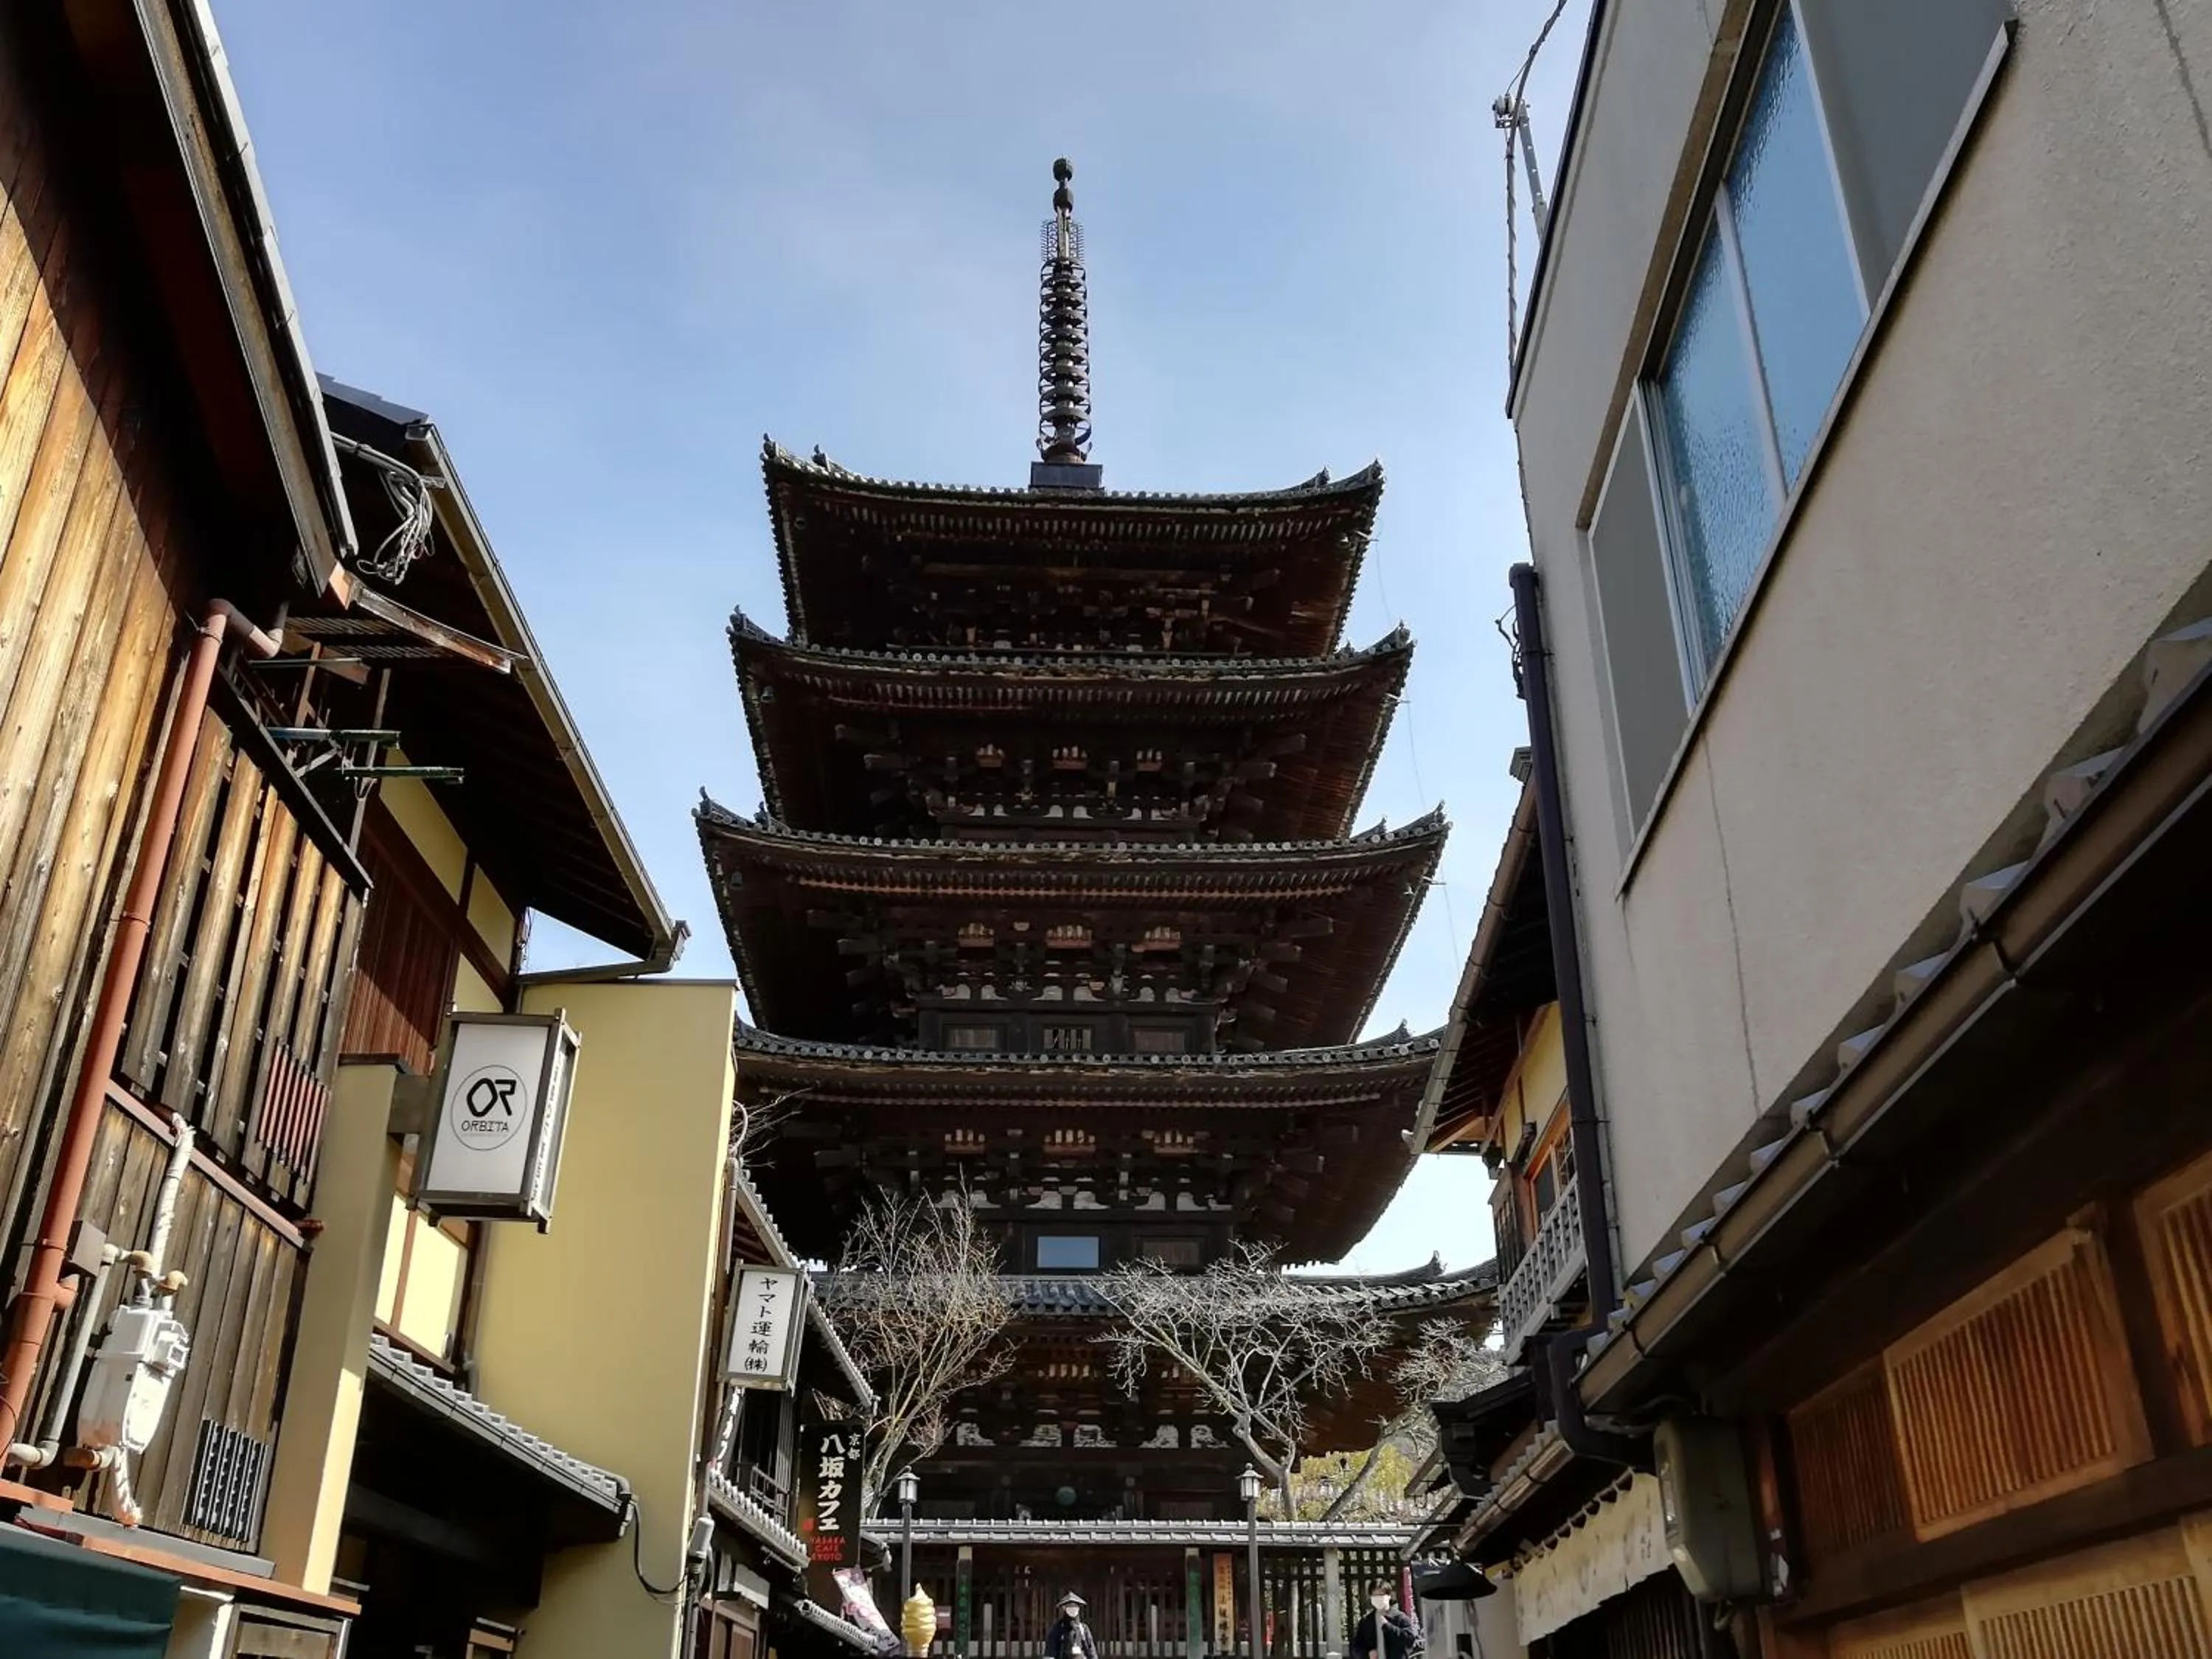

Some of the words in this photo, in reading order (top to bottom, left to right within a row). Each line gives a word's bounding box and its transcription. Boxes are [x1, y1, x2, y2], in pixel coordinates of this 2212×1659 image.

[461, 1121, 509, 1133] ORBITA
[847, 1433, 861, 1461] 京都
[818, 1433, 846, 1531] 八坂カフェ
